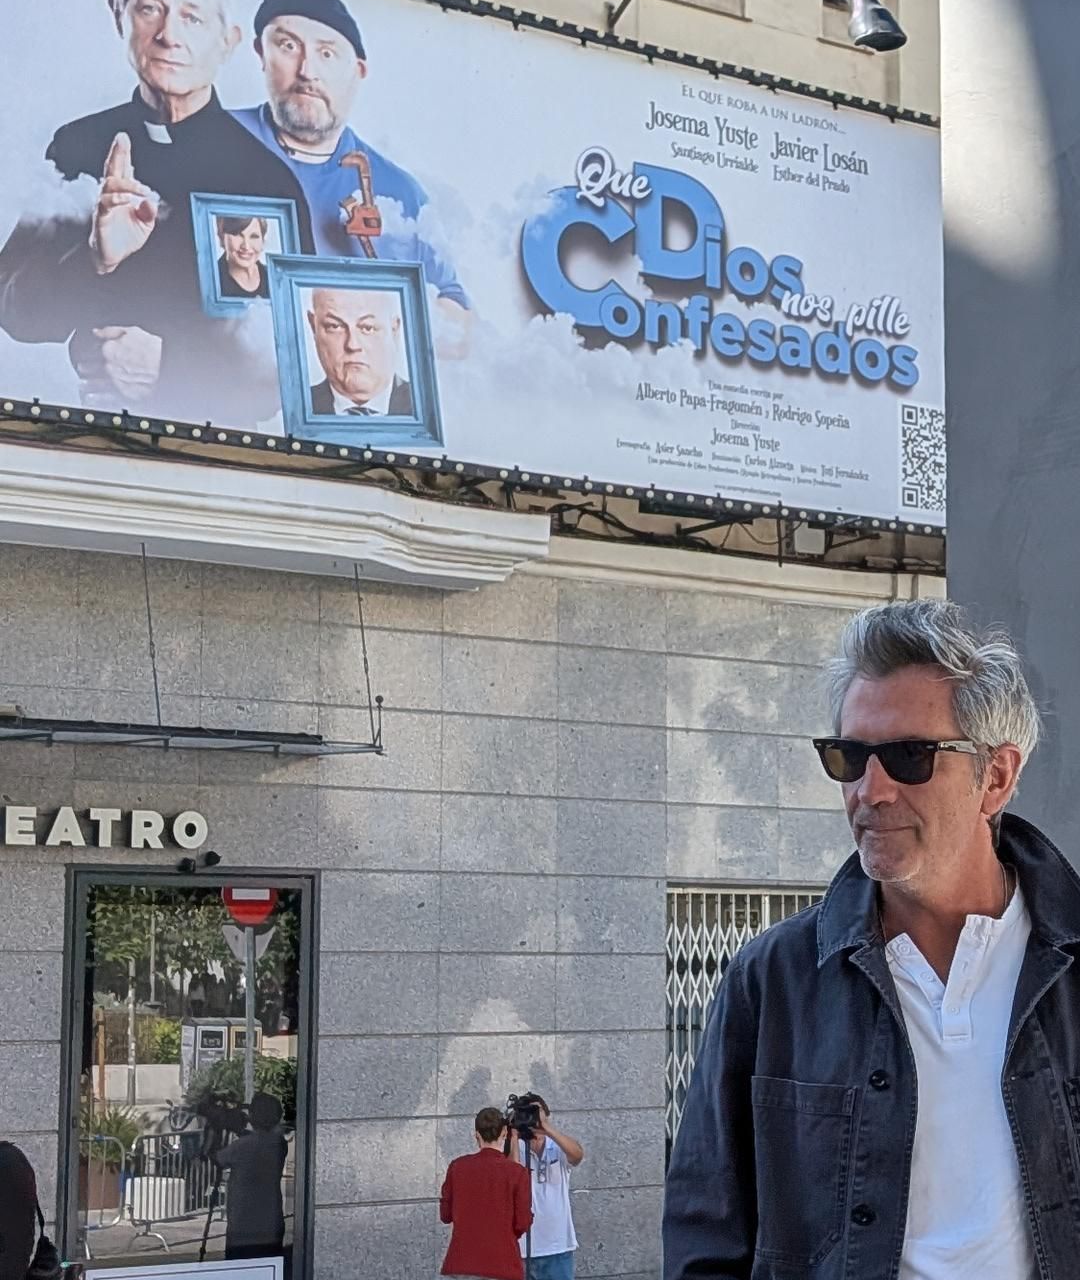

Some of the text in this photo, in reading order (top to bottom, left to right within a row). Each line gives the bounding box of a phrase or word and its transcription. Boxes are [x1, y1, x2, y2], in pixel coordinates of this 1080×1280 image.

[682, 84, 695, 98] EL
[698, 90, 725, 105] QUE
[727, 96, 757, 114] ROBA
[760, 105, 768, 116] A
[771, 107, 788, 120] UN
[645, 101, 759, 151] Josema Yuste
[670, 141, 759, 174] Santiago Urrialde
[770, 131, 869, 176] Javier Losán
[773, 164, 850, 194] Esther del Prado
[575, 146, 806, 303] Que Dios
[521, 184, 920, 390] Confesados
[780, 289, 912, 339] nos pille
[636, 381, 677, 404] Alberto
[680, 388, 763, 416] Papa-Fragomén
[772, 403, 812, 426] Rodrigo
[815, 409, 851, 430] Sopeña
[710, 427, 781, 452] Josema Yuste
[4, 805, 209, 850] EATRO
